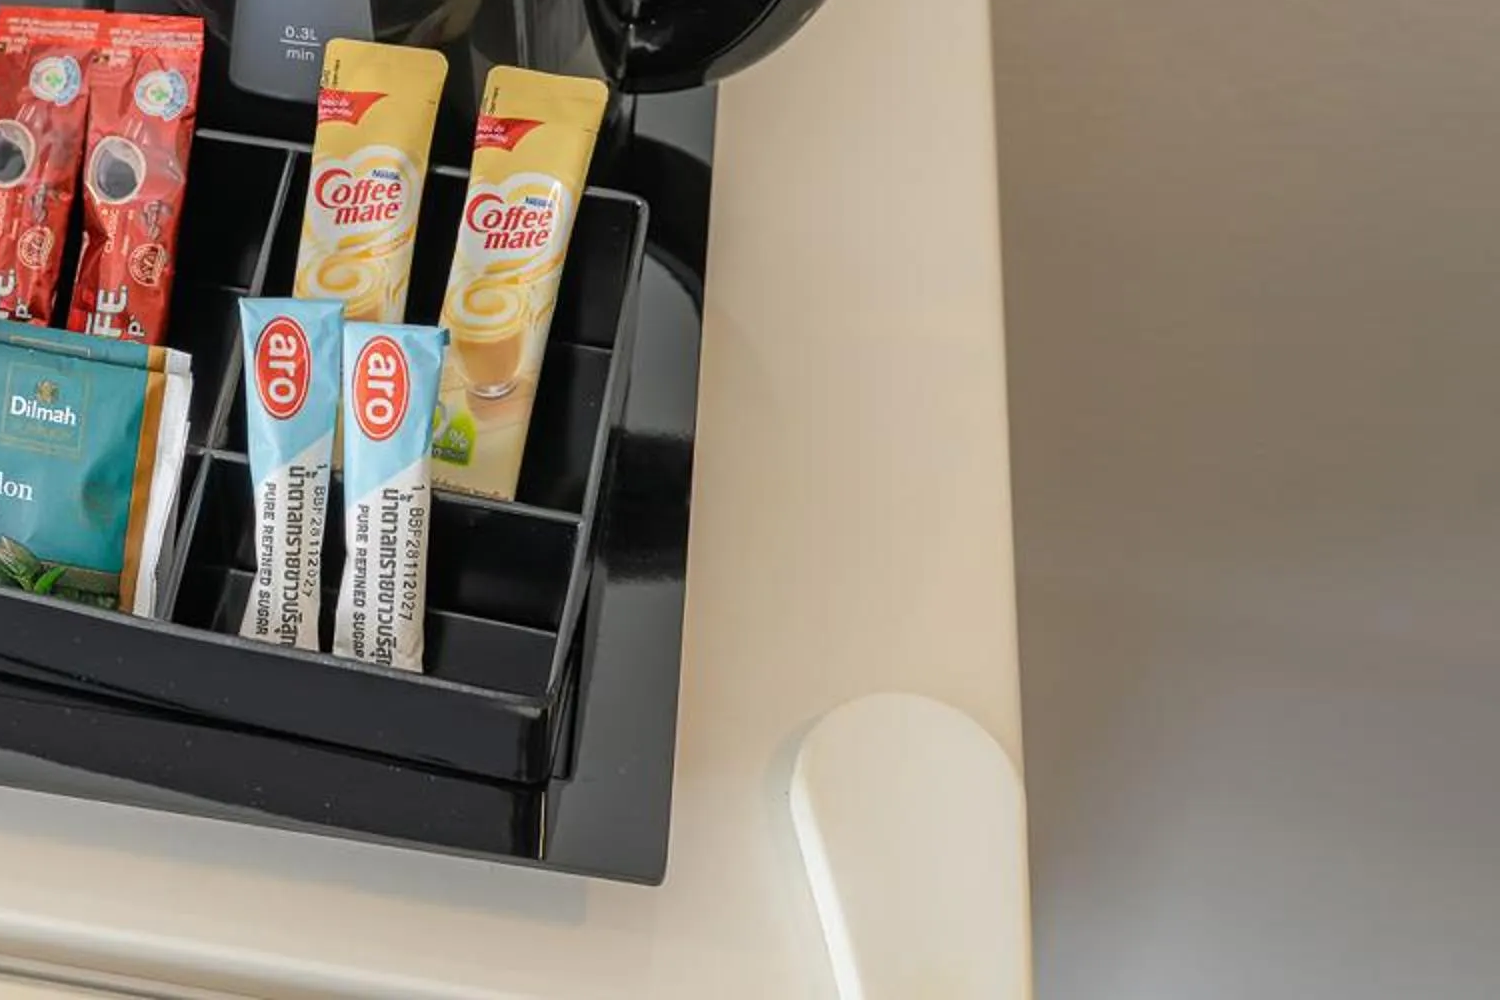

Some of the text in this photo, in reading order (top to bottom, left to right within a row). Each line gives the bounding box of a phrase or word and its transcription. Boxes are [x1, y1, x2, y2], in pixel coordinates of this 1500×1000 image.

[285, 25, 319, 41] 0.3L
[286, 47, 315, 62] min
[315, 167, 402, 209] Coffee
[334, 202, 402, 225] mate
[466, 193, 553, 232] Coffee
[484, 227, 549, 250] mate
[268, 330, 298, 403] aro
[364, 352, 399, 426] aro
[10, 395, 77, 425] Dilmah
[356, 503, 370, 543] PURE
[255, 481, 277, 636] PURE REFINED SUGAR
[274, 465, 318, 647] น้ำตาลทรายขาวบริสุท
[353, 547, 369, 608] REFINED
